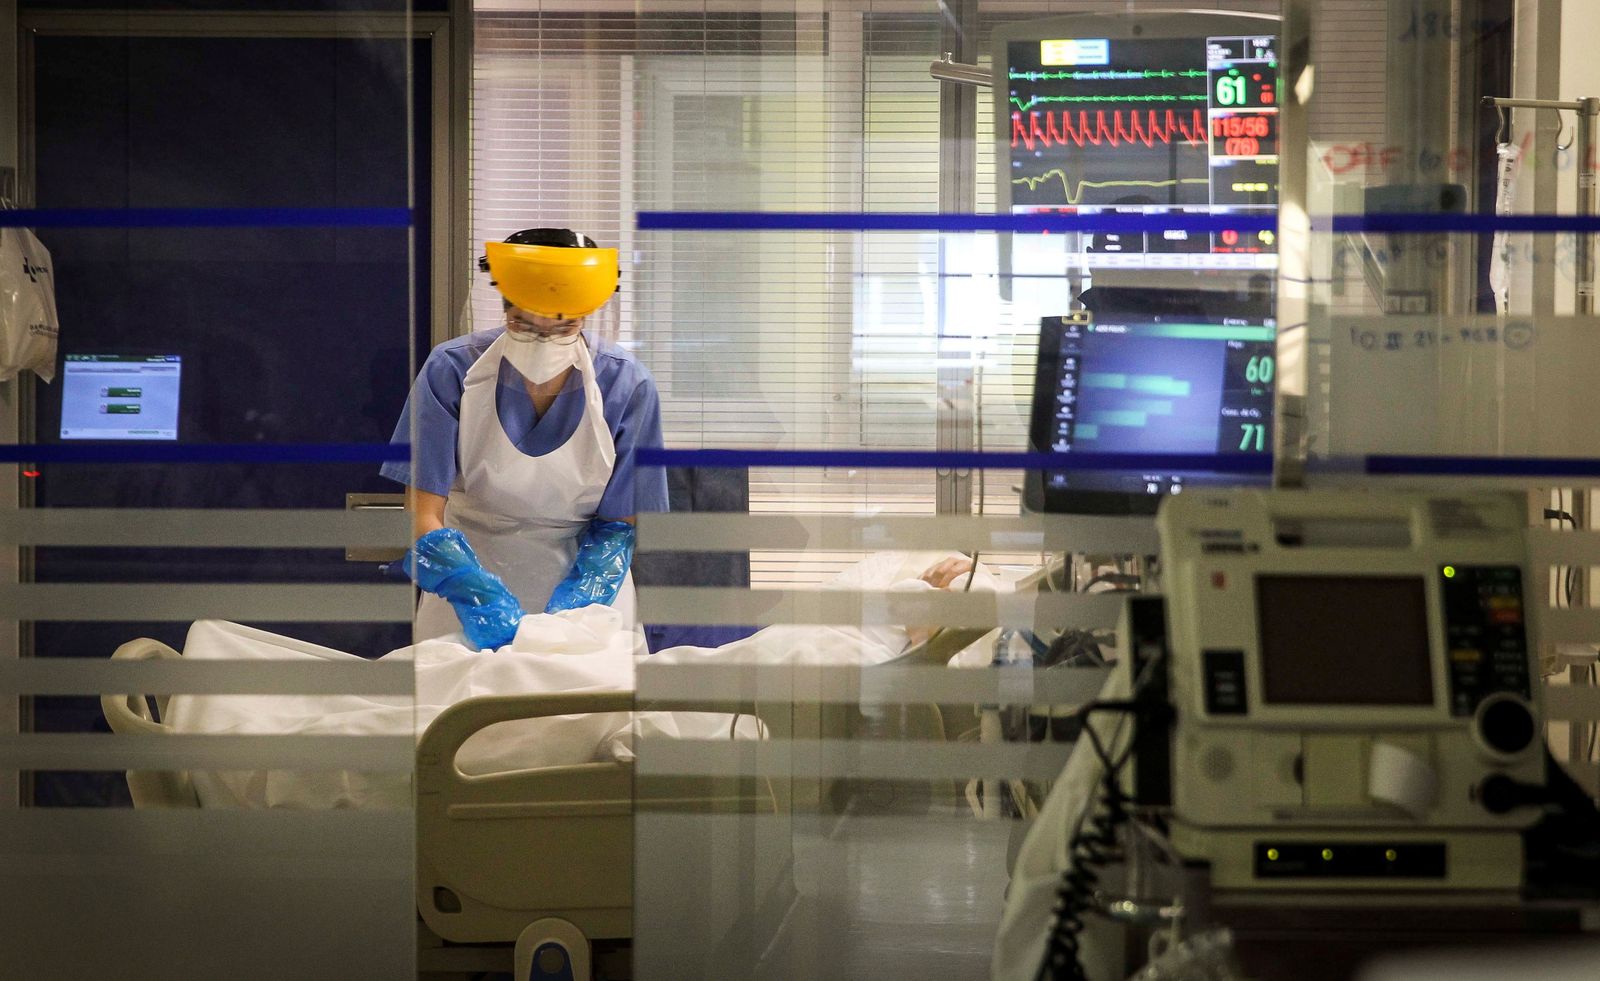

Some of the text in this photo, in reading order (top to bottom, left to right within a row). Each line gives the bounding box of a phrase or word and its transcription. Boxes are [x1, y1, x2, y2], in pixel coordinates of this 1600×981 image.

[1216, 76, 1246, 105] 61
[1212, 116, 1269, 137] 115/56
[1225, 137, 1260, 155] (76)
[1245, 355, 1275, 383] 60
[1239, 423, 1265, 452] 71
